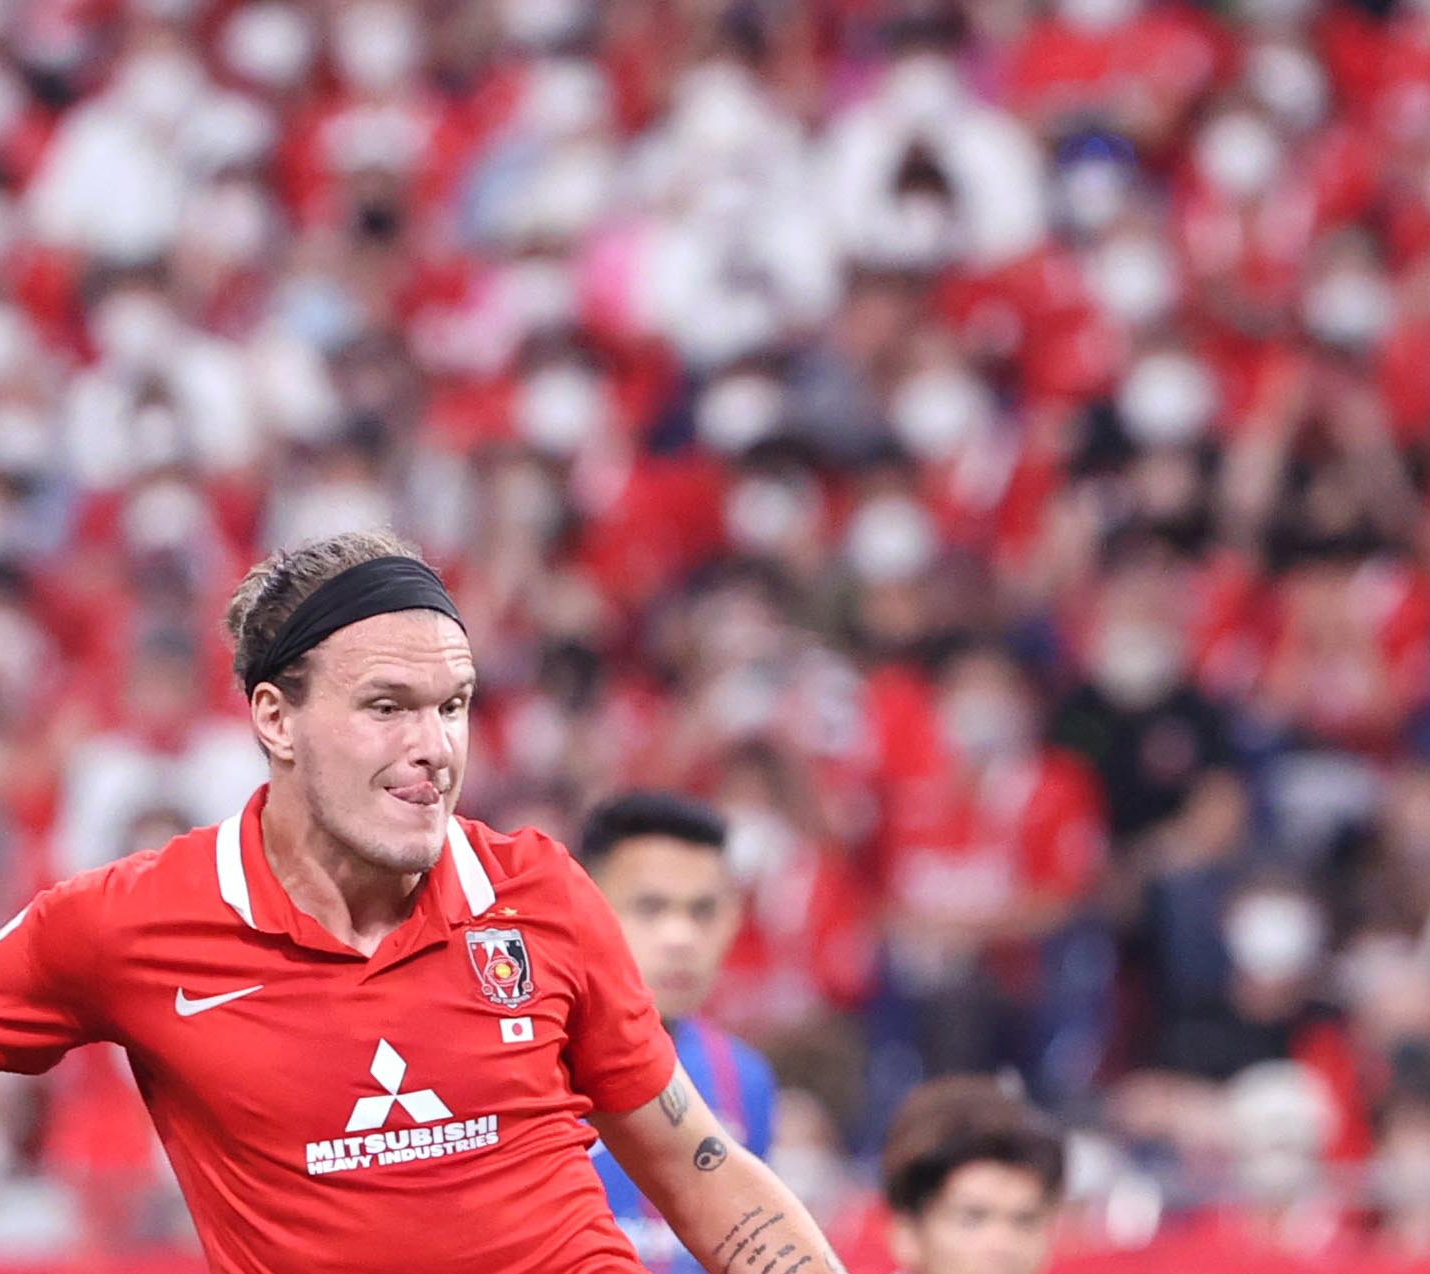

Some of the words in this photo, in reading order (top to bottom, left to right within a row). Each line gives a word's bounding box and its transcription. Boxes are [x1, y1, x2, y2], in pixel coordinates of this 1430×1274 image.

[306, 1114, 498, 1163] MITSUBISHI
[307, 1155, 373, 1175] HEAVY
[378, 1132, 499, 1166] INDUSTRIES
